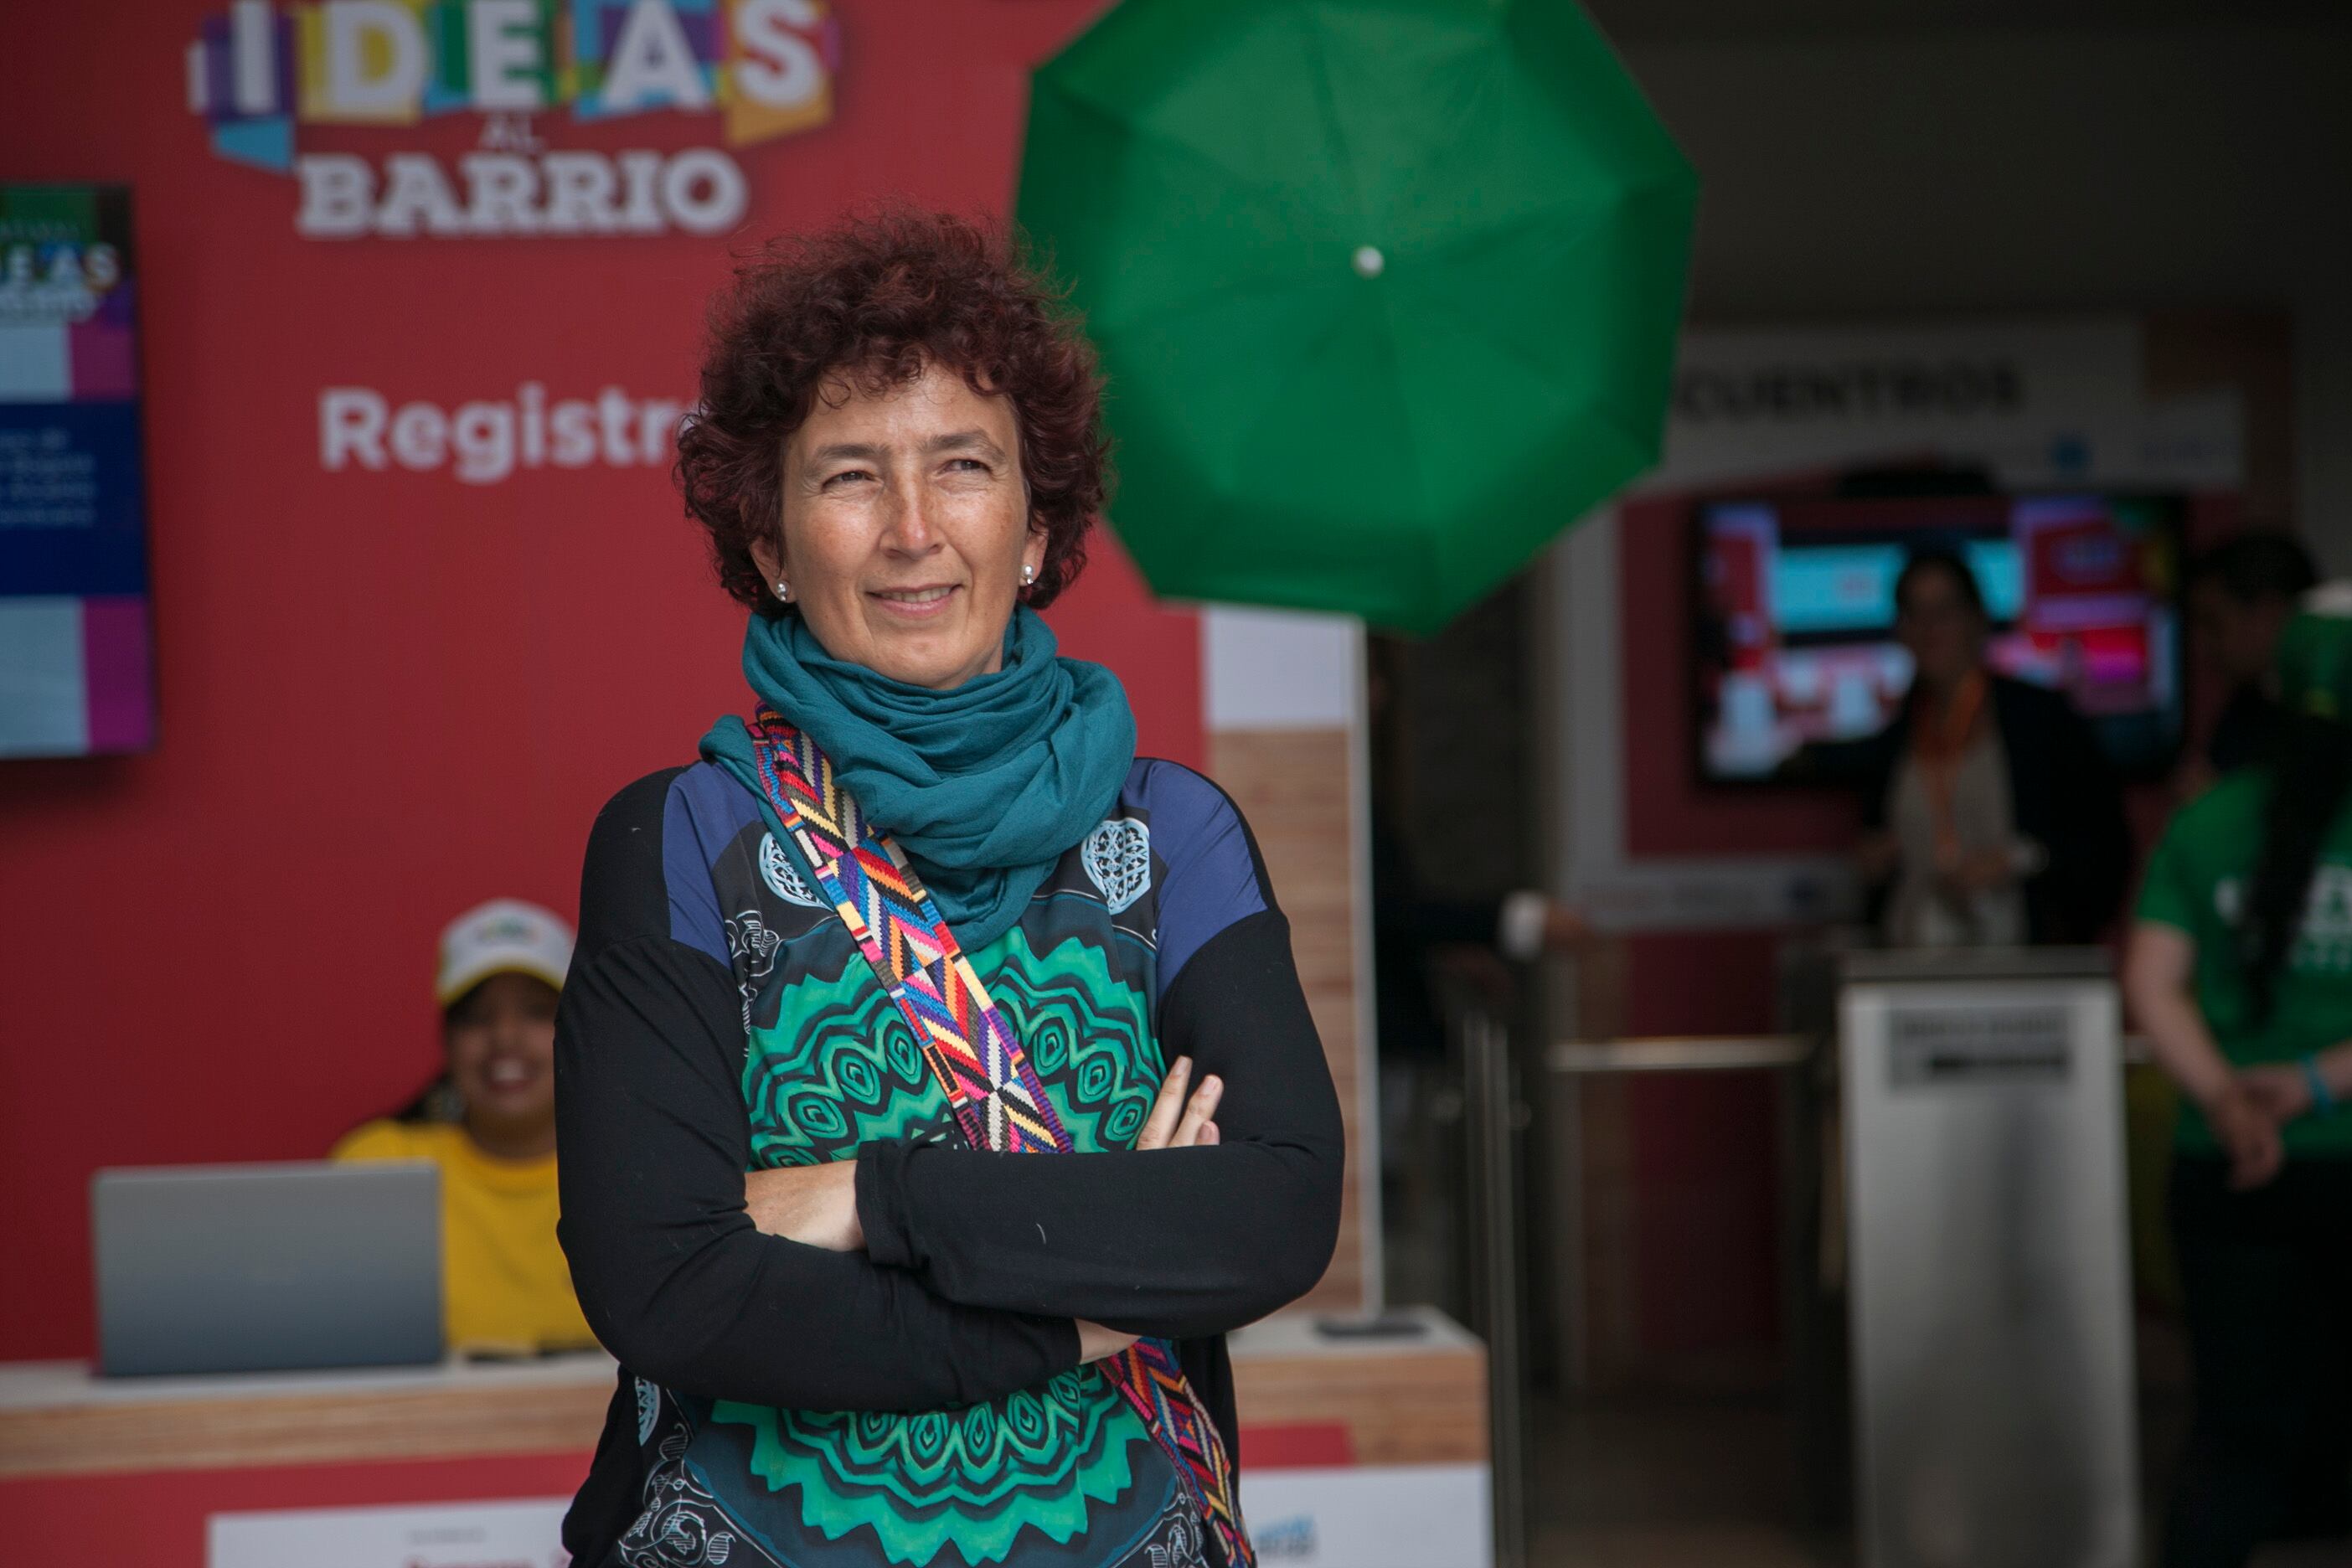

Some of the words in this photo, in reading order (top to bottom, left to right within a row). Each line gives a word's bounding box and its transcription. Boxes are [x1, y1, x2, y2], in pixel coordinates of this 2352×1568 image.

[235, 0, 827, 112] IDEAS
[478, 116, 544, 152] AL
[297, 150, 750, 238] BARRIO
[0, 242, 119, 286] EAS
[319, 382, 702, 484] Registr
